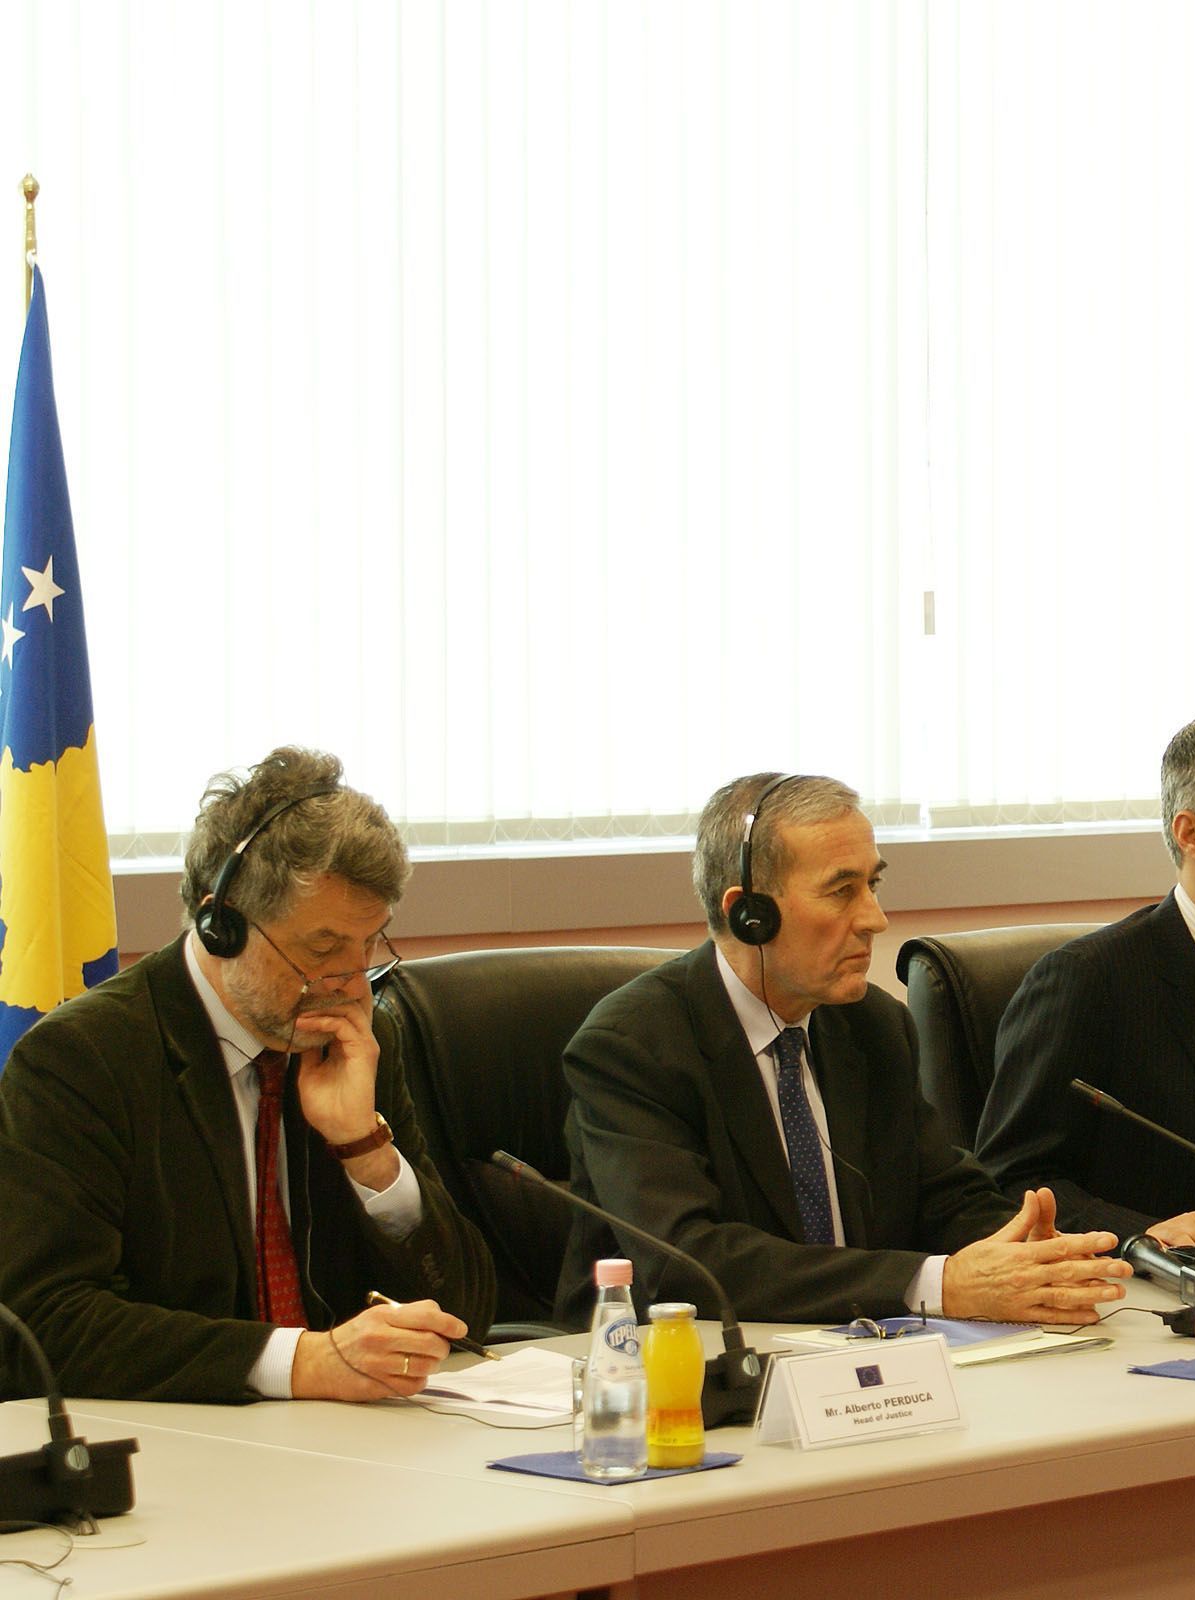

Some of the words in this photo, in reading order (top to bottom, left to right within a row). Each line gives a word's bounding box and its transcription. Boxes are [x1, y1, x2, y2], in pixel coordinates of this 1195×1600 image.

[825, 1407, 842, 1418] Mr.
[845, 1401, 881, 1415] Alberto
[884, 1392, 933, 1408] PERDUCA
[853, 1415, 874, 1425] Head
[875, 1413, 884, 1422] of
[886, 1409, 913, 1420] Justice
